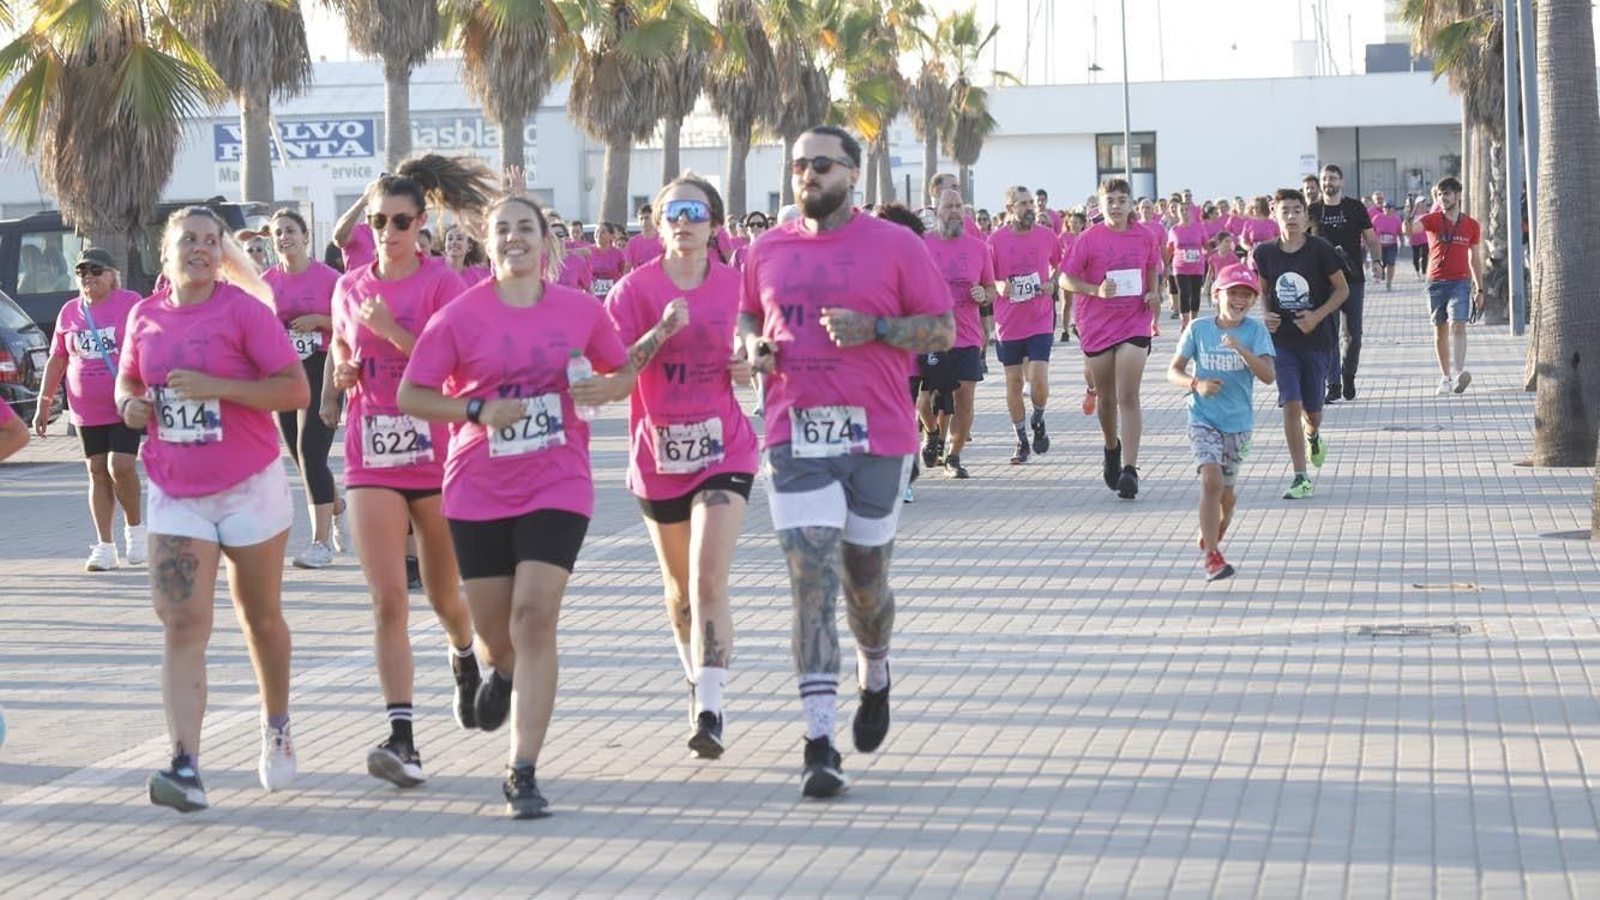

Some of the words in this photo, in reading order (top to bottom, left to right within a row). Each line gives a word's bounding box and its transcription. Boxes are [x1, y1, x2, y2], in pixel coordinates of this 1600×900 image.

[779, 304, 804, 327] VI
[662, 364, 686, 385] VI
[162, 402, 208, 429] 614
[372, 427, 420, 455] 622
[804, 417, 854, 444] 674
[665, 434, 711, 461] 678
